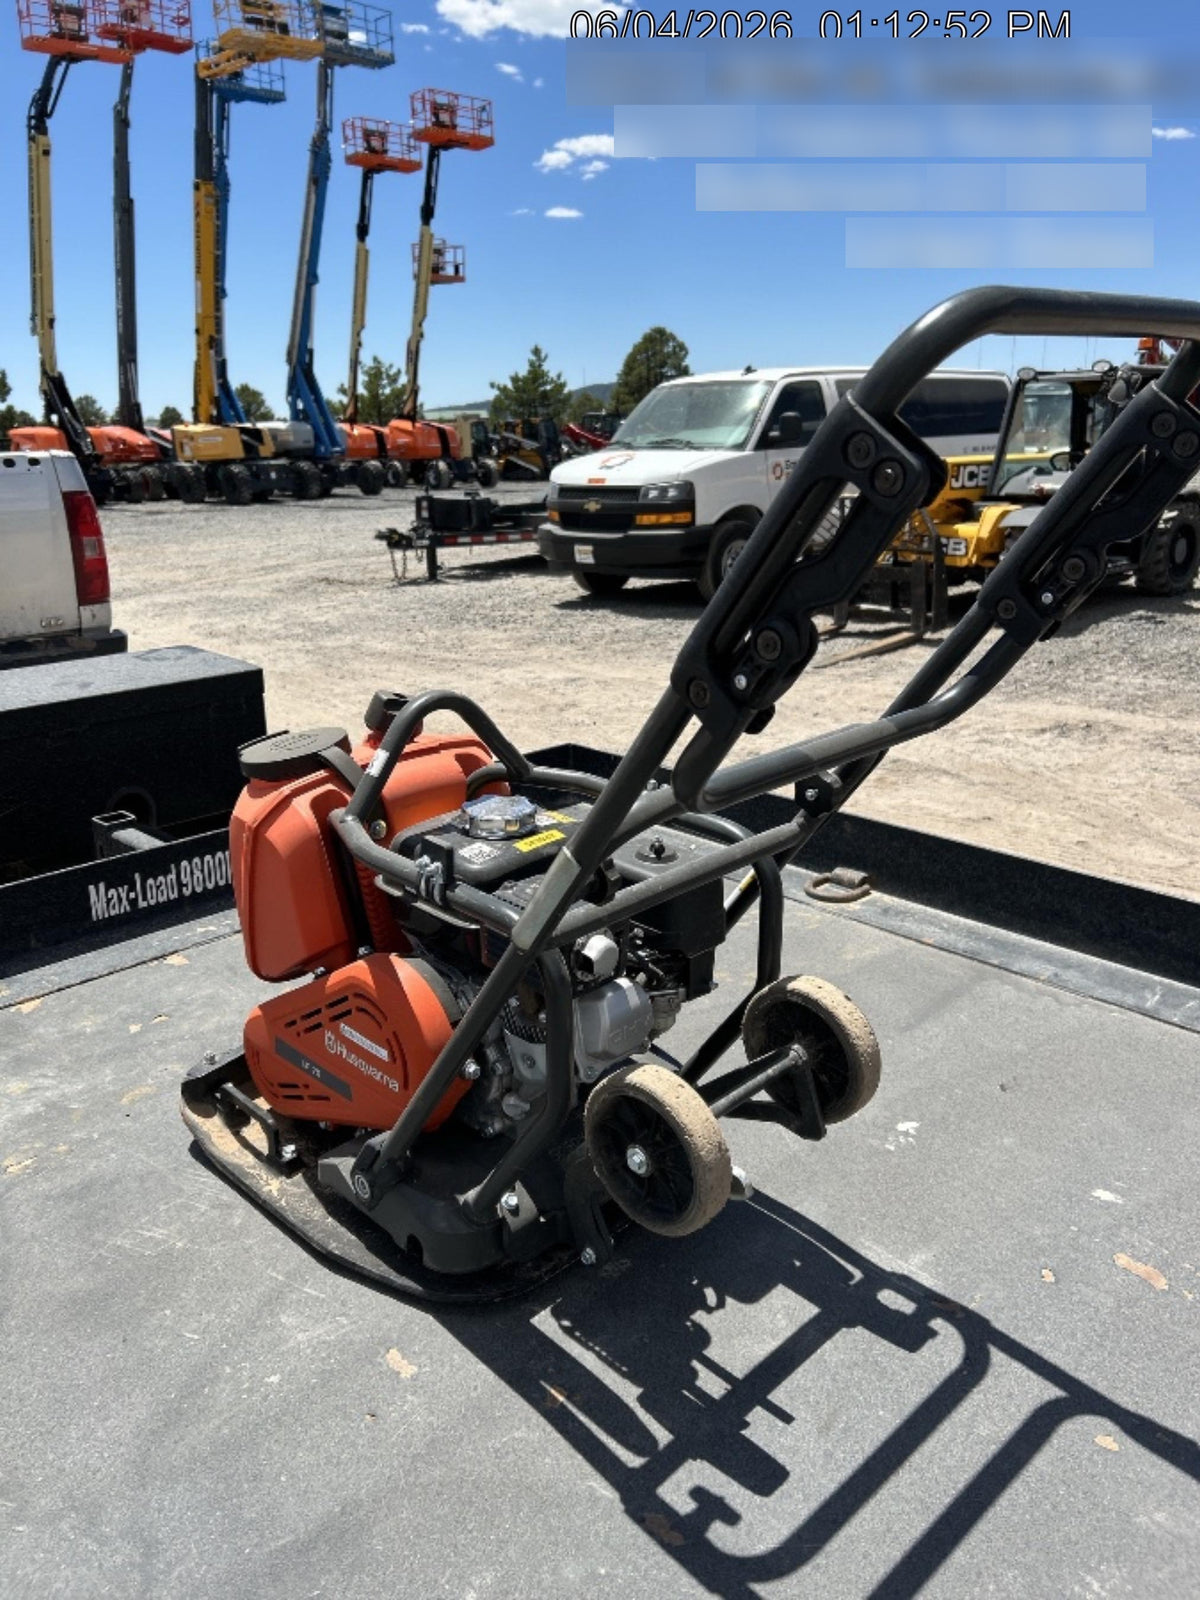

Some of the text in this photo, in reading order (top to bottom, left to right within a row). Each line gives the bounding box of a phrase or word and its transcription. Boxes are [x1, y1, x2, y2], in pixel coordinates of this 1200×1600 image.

[951, 465, 990, 489] JCB
[88, 863, 178, 921] Max-Load
[337, 1041, 399, 1093] Husqvarna
